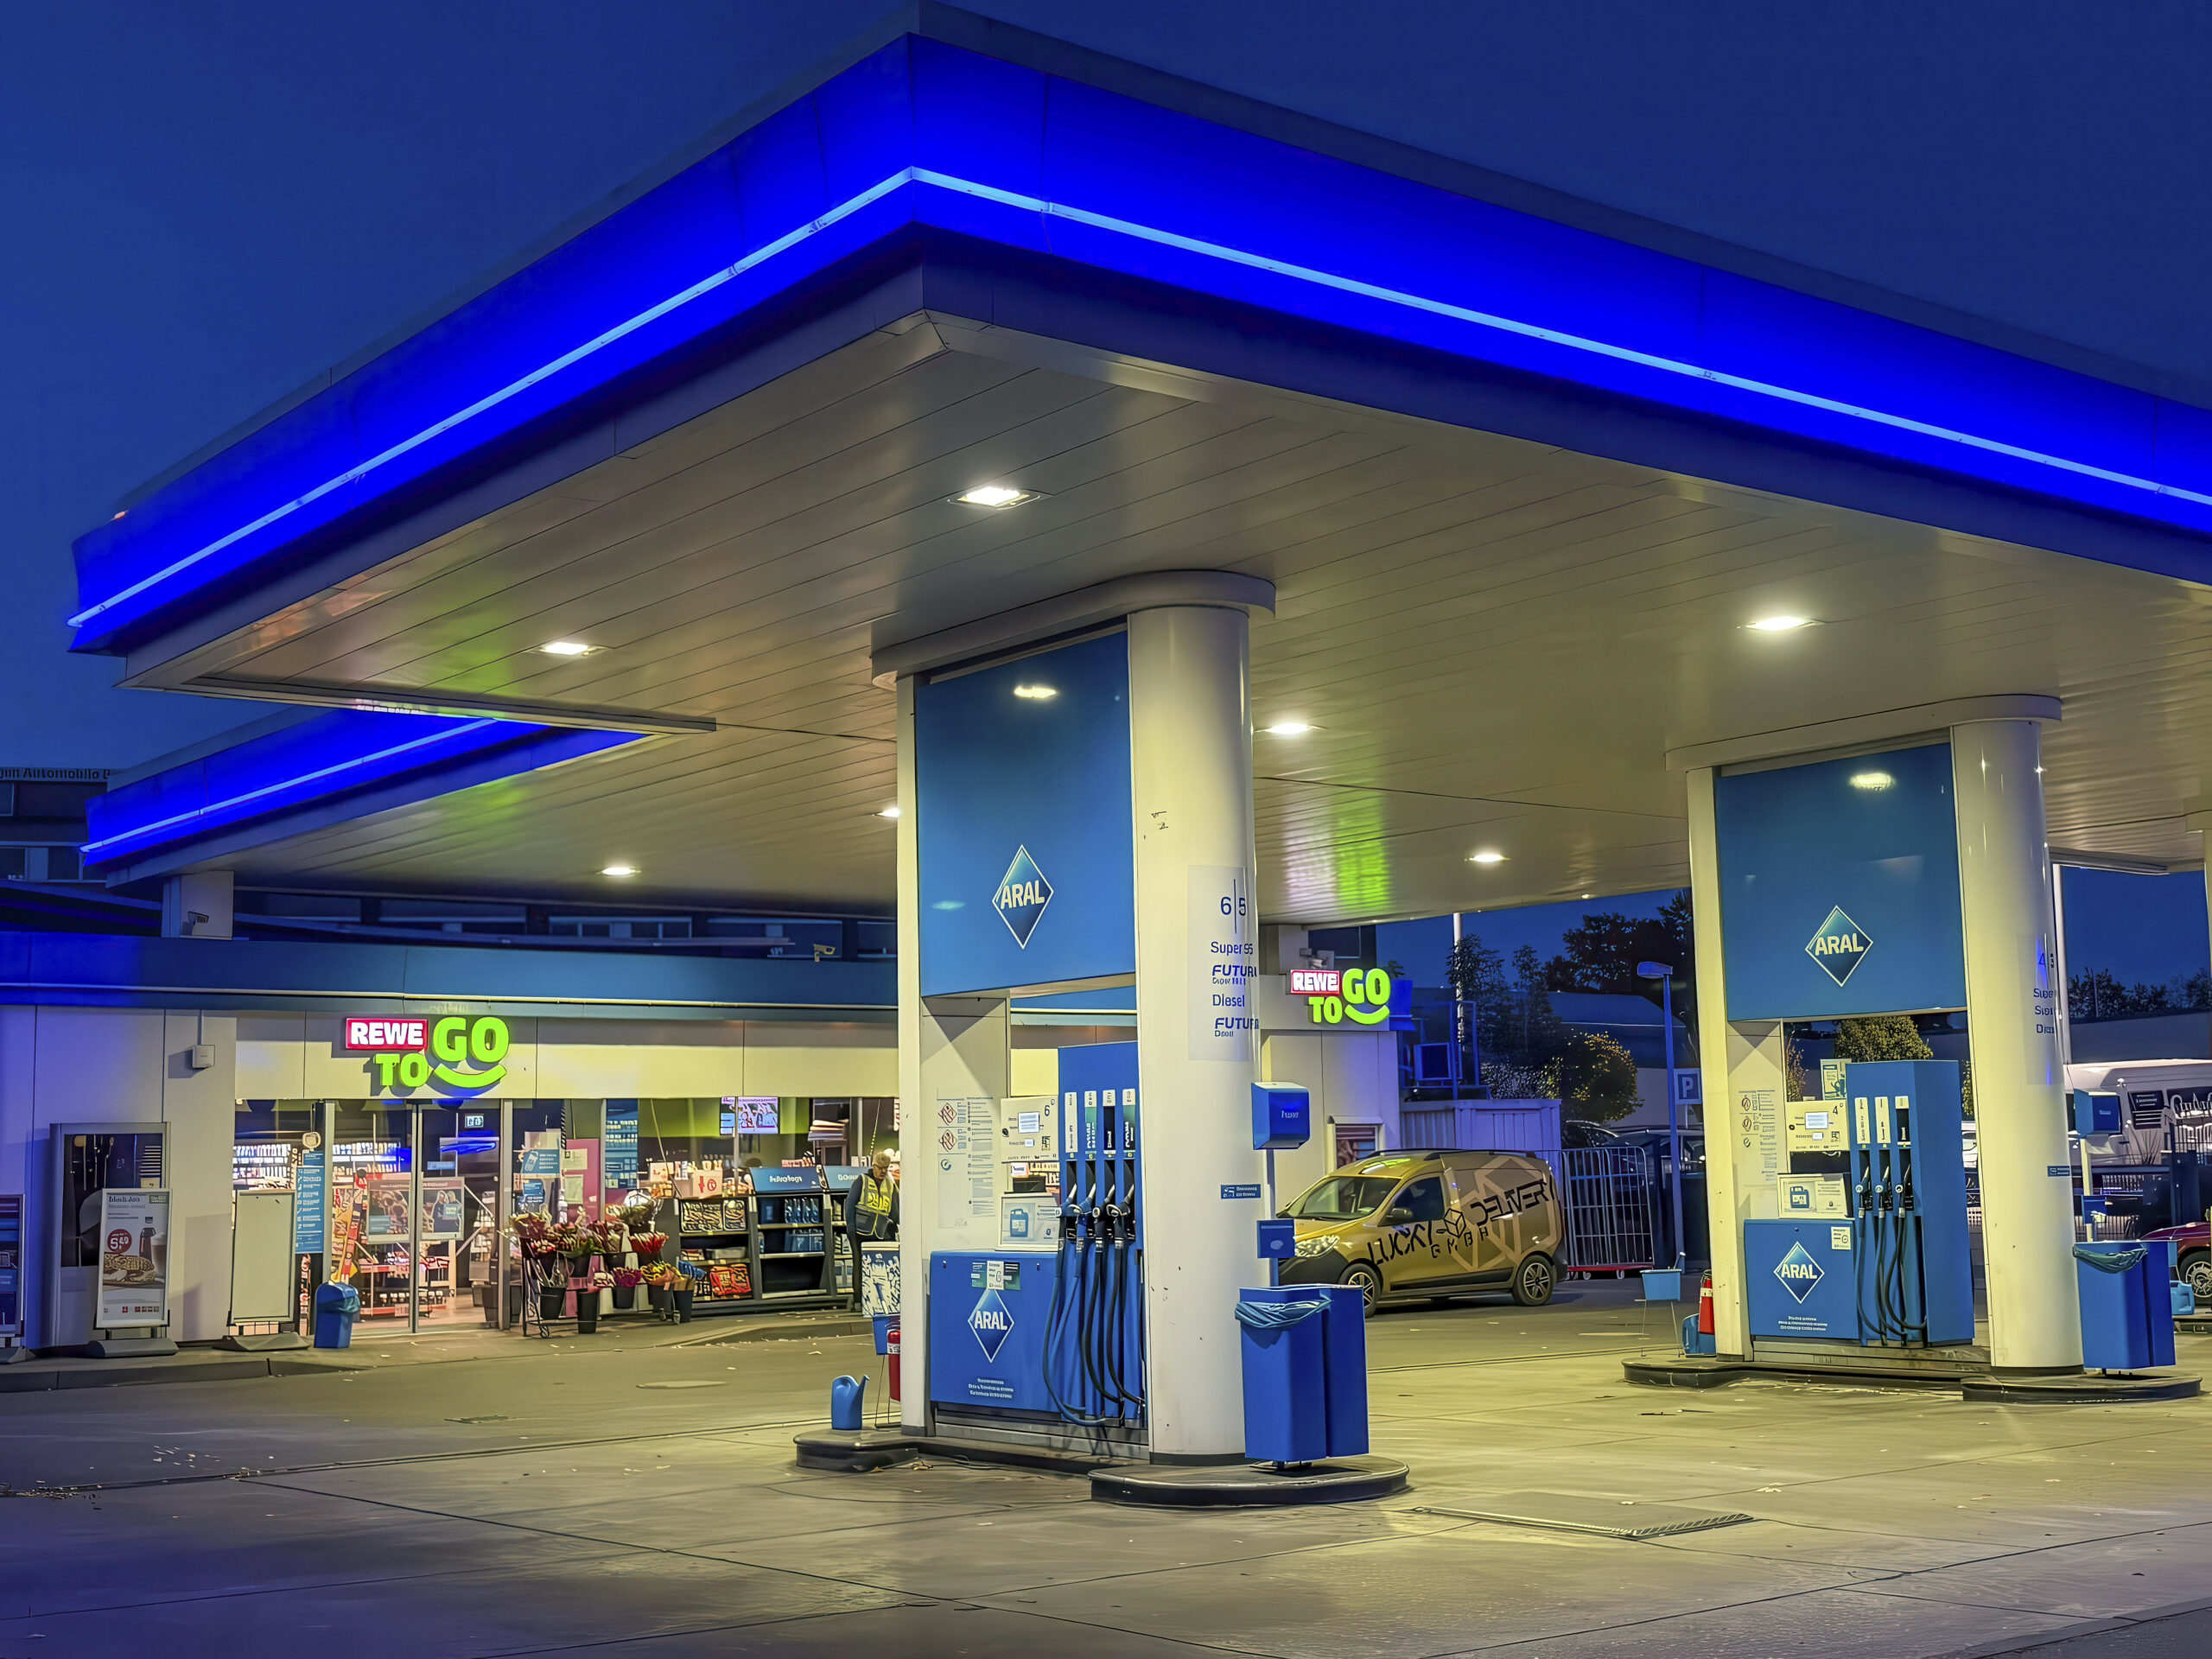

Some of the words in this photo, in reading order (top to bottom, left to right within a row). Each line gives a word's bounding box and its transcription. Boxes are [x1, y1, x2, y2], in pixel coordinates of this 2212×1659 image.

[1001, 880, 1046, 910] ARAL
[1220, 896, 1232, 916] 6
[1238, 897, 1247, 917] 5
[1211, 941, 1243, 957] Super
[1815, 932, 1865, 957] ARAL
[1293, 972, 1338, 993] REWE
[1213, 994, 1245, 1007] Diesel
[1308, 995, 1344, 1024] TO
[1342, 968, 1391, 1006] GO
[350, 1021, 424, 1046] REWE
[374, 1052, 429, 1087] TO
[433, 1016, 510, 1063] GO
[1681, 1077, 1694, 1098] P
[1044, 1104, 1051, 1116] 6
[1781, 1263, 1818, 1280] ARAL
[974, 1310, 1008, 1331] ARAL
